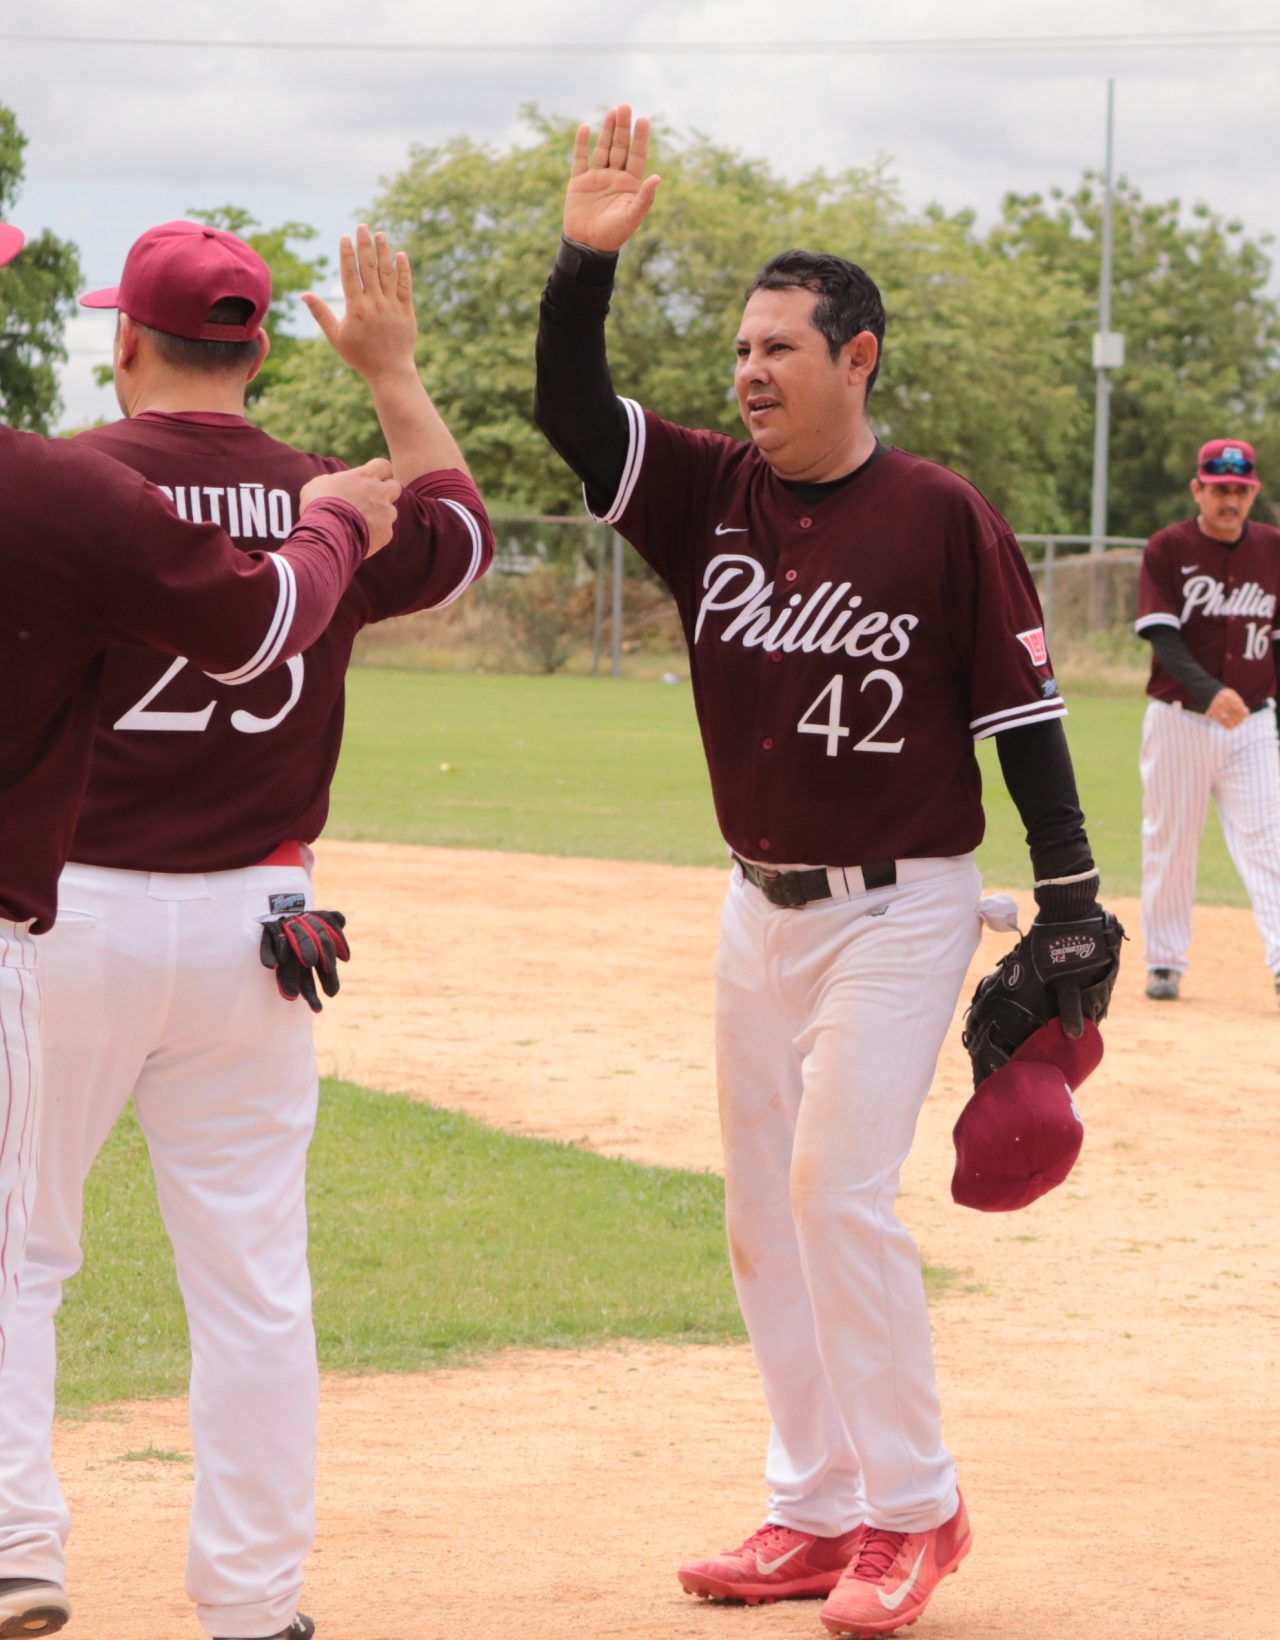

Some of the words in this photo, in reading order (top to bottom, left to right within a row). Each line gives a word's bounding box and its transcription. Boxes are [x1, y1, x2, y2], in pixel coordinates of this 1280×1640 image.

[157, 483, 293, 539] UTIÑO
[694, 553, 919, 662] Phillies
[1242, 622, 1272, 661] 16
[797, 668, 905, 757] 42
